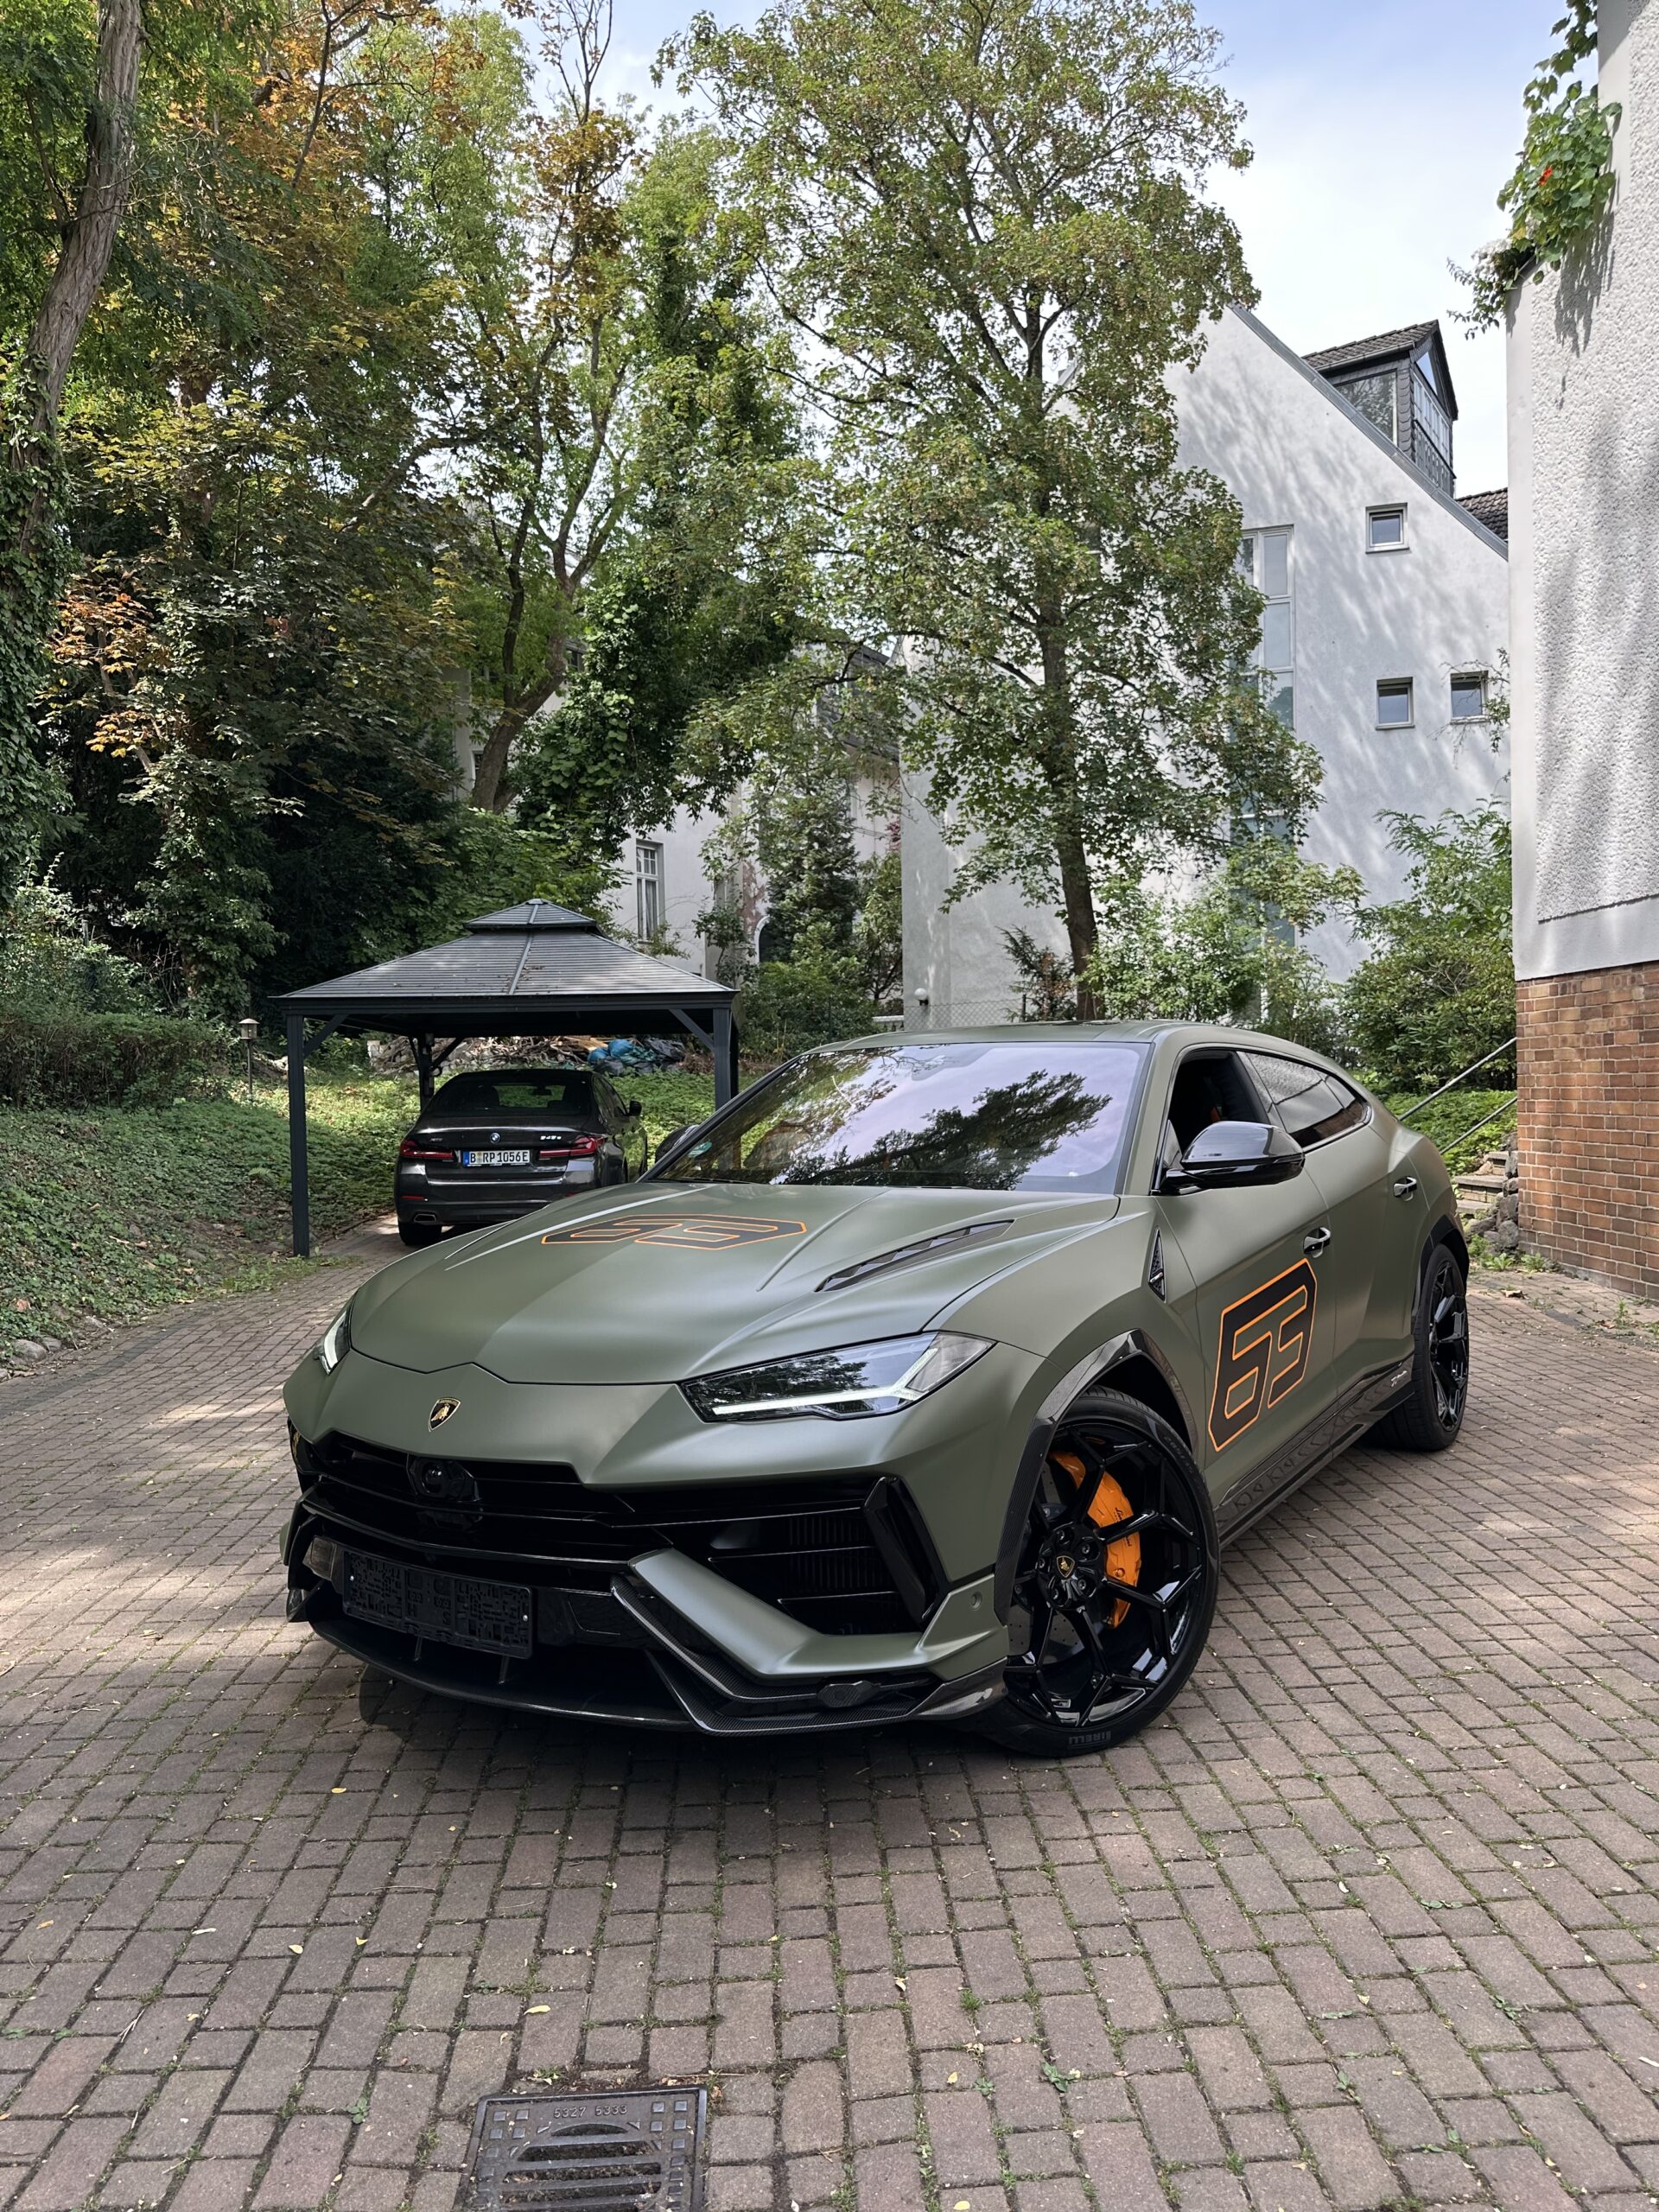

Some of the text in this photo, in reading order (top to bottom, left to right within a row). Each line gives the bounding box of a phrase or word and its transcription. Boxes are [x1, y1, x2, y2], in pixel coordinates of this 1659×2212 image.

[470, 1153, 476, 1163] B
[541, 1213, 807, 1250] 63
[1208, 1257, 1318, 1452] 63
[554, 2104, 627, 2119] 5327 5333
